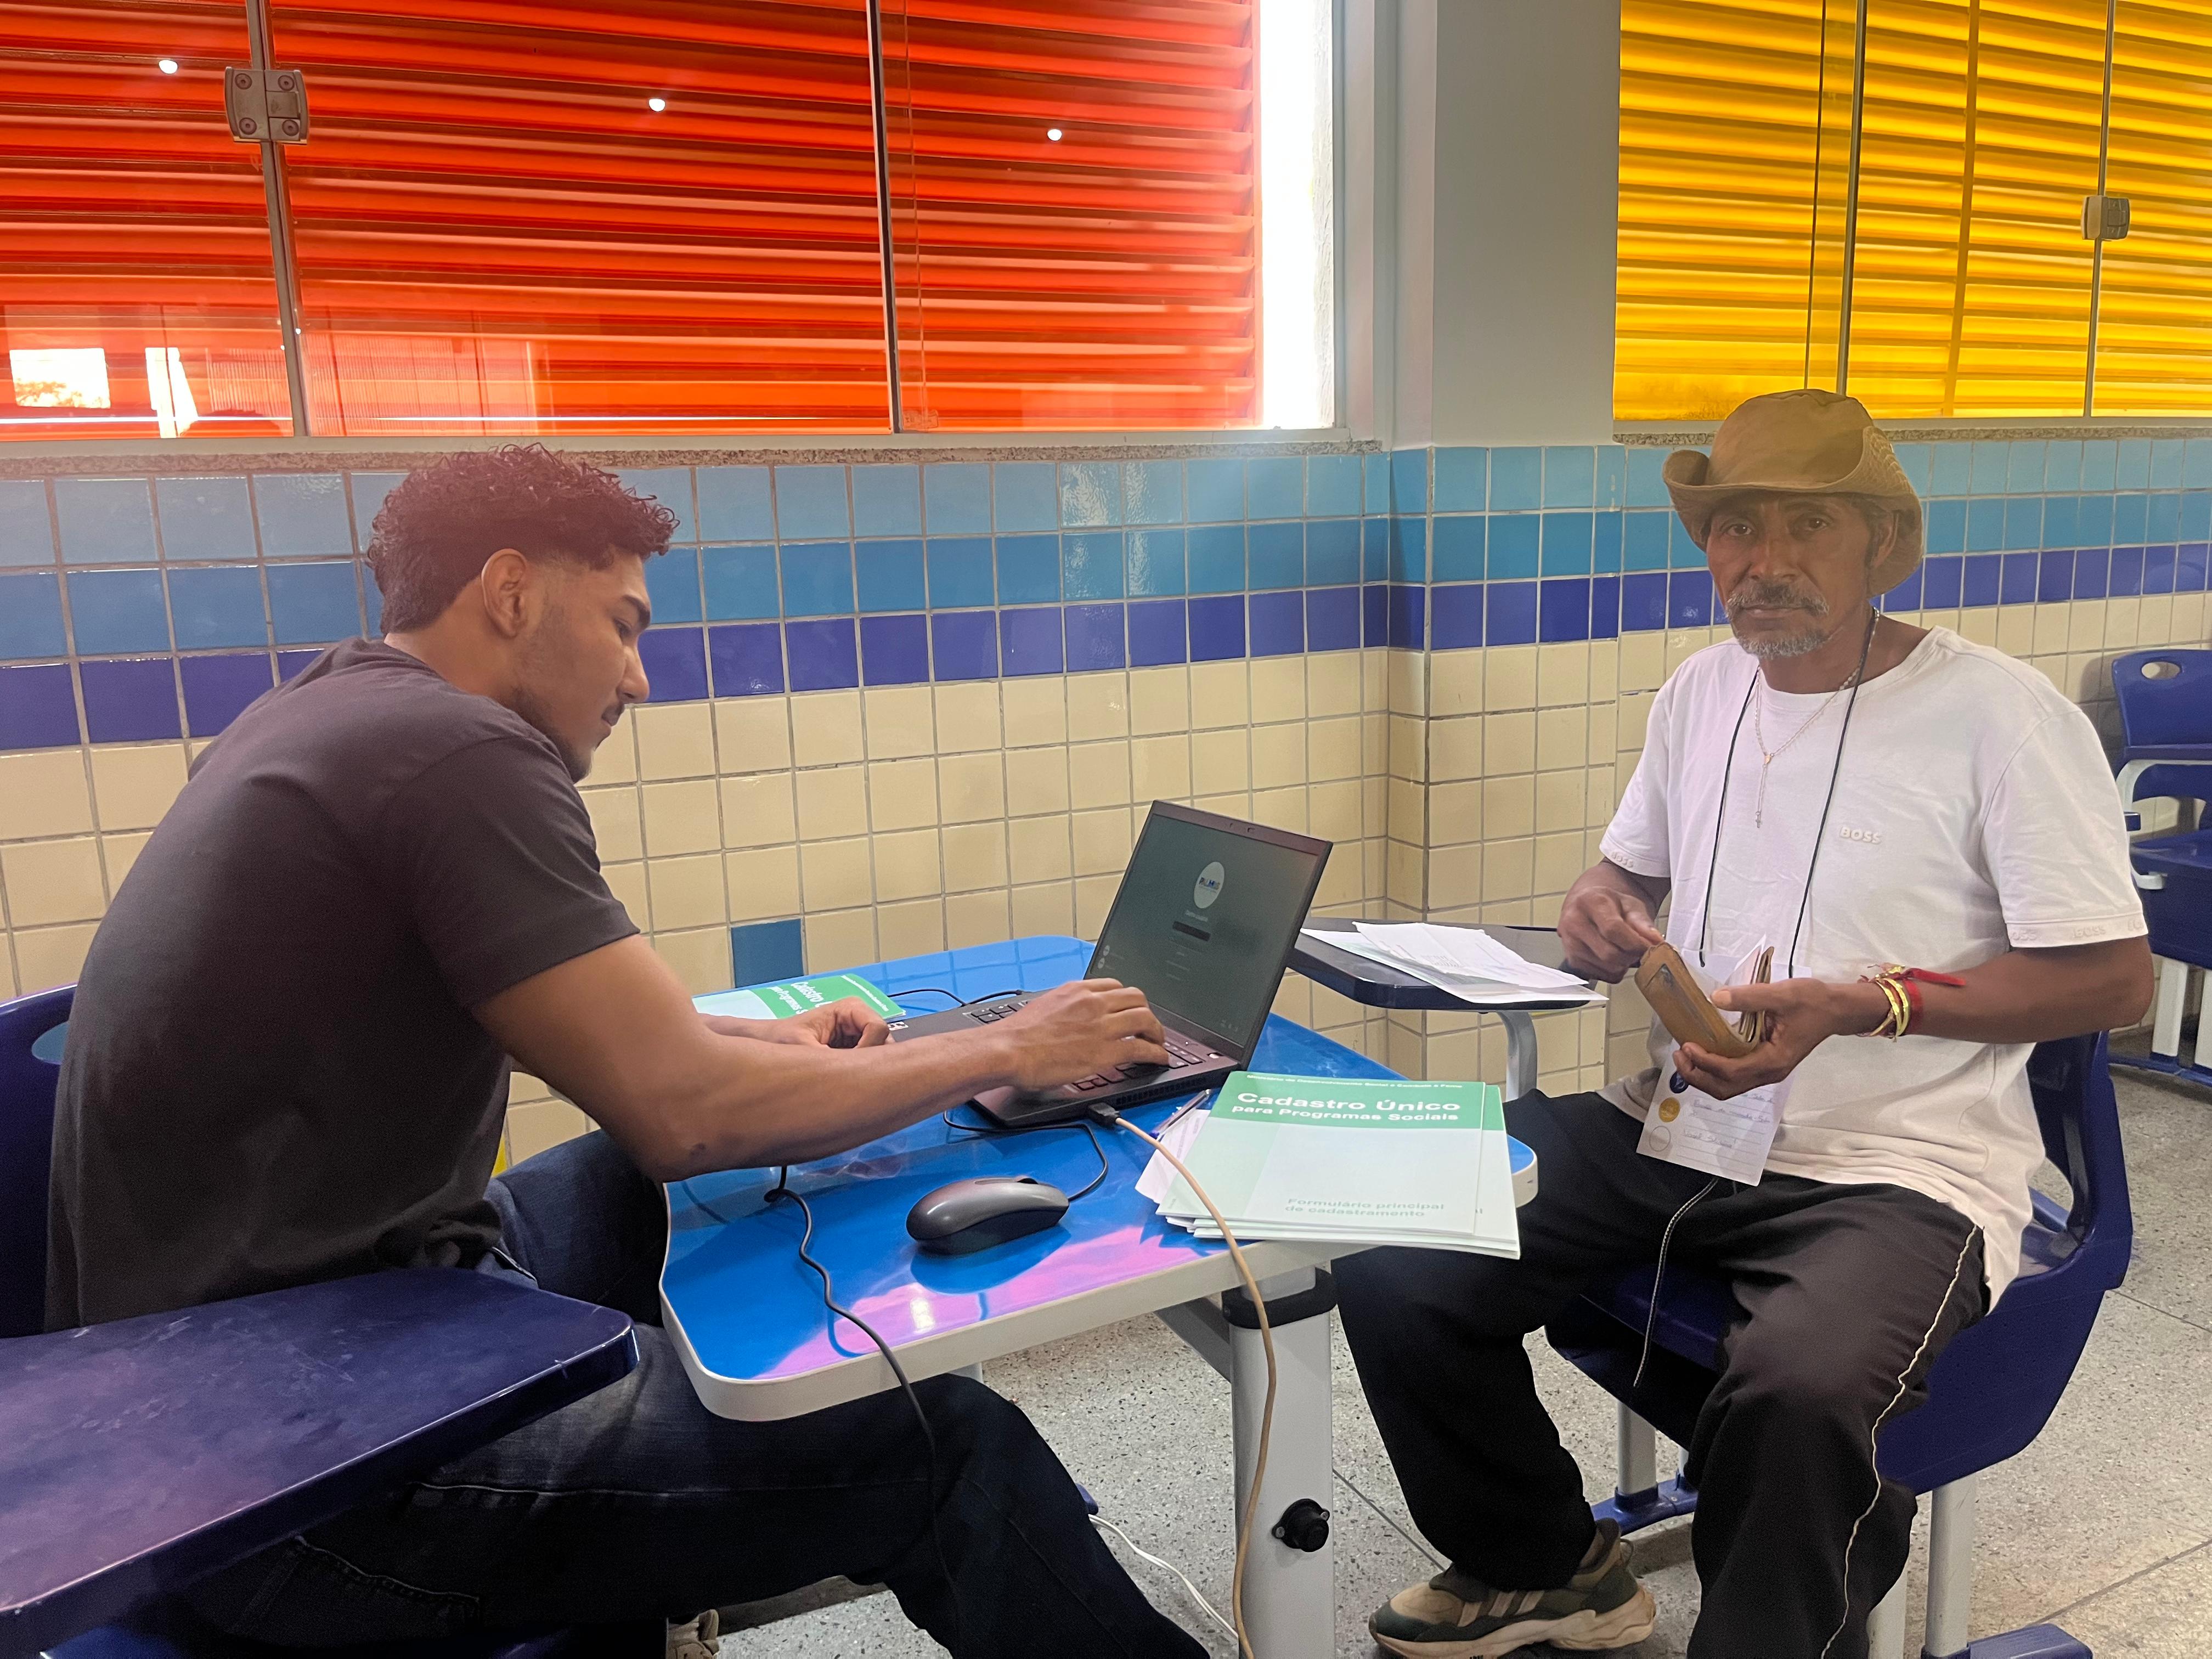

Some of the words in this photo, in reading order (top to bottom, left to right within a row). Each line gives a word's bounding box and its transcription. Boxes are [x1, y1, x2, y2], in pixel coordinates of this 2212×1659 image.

[1839, 826, 1882, 844] BOSS
[1238, 1093, 1366, 1110] Cadastro
[1376, 1099, 1461, 1111] Único
[1279, 1108, 1382, 1119] Programas
[1288, 1198, 1372, 1208] Formulário
[1308, 1207, 1425, 1217] cadastramento
